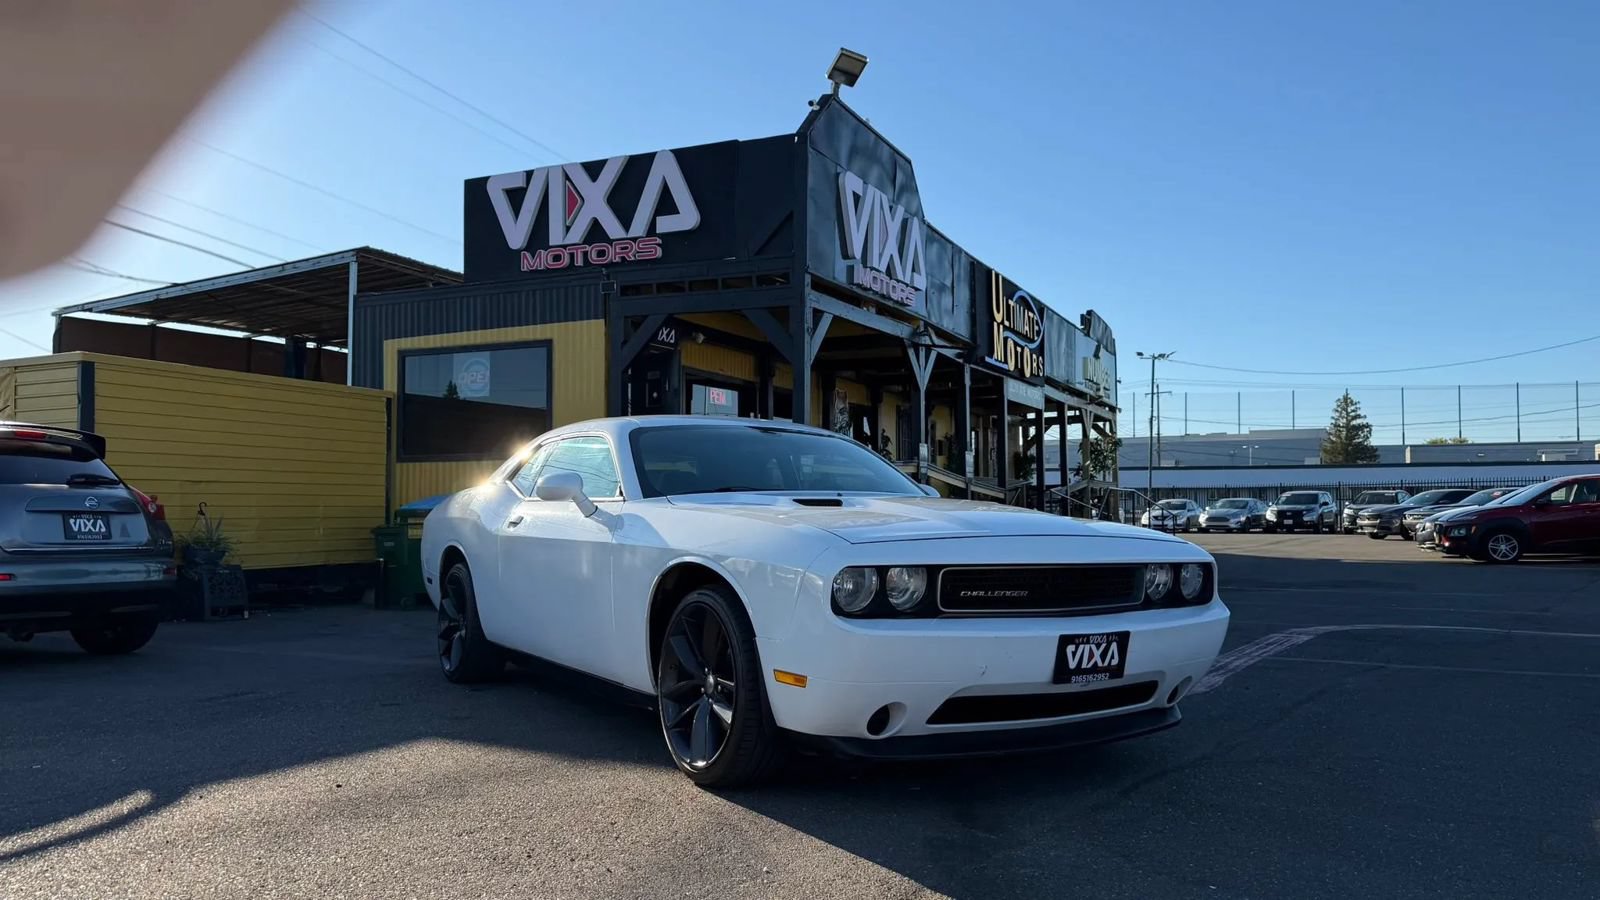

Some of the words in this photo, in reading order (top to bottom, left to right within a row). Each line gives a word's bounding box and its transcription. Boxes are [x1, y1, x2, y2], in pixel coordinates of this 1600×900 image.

[486, 149, 701, 250] VIXA
[839, 170, 927, 292] VIXA
[520, 236, 663, 272] MOTORS
[854, 266, 916, 307] MOTORS
[991, 269, 1040, 341] ULTIMATE
[657, 326, 676, 344] IXA
[993, 320, 1044, 378] MOTORS
[69, 518, 107, 532] VIXA
[1066, 641, 1119, 670] VIXA
